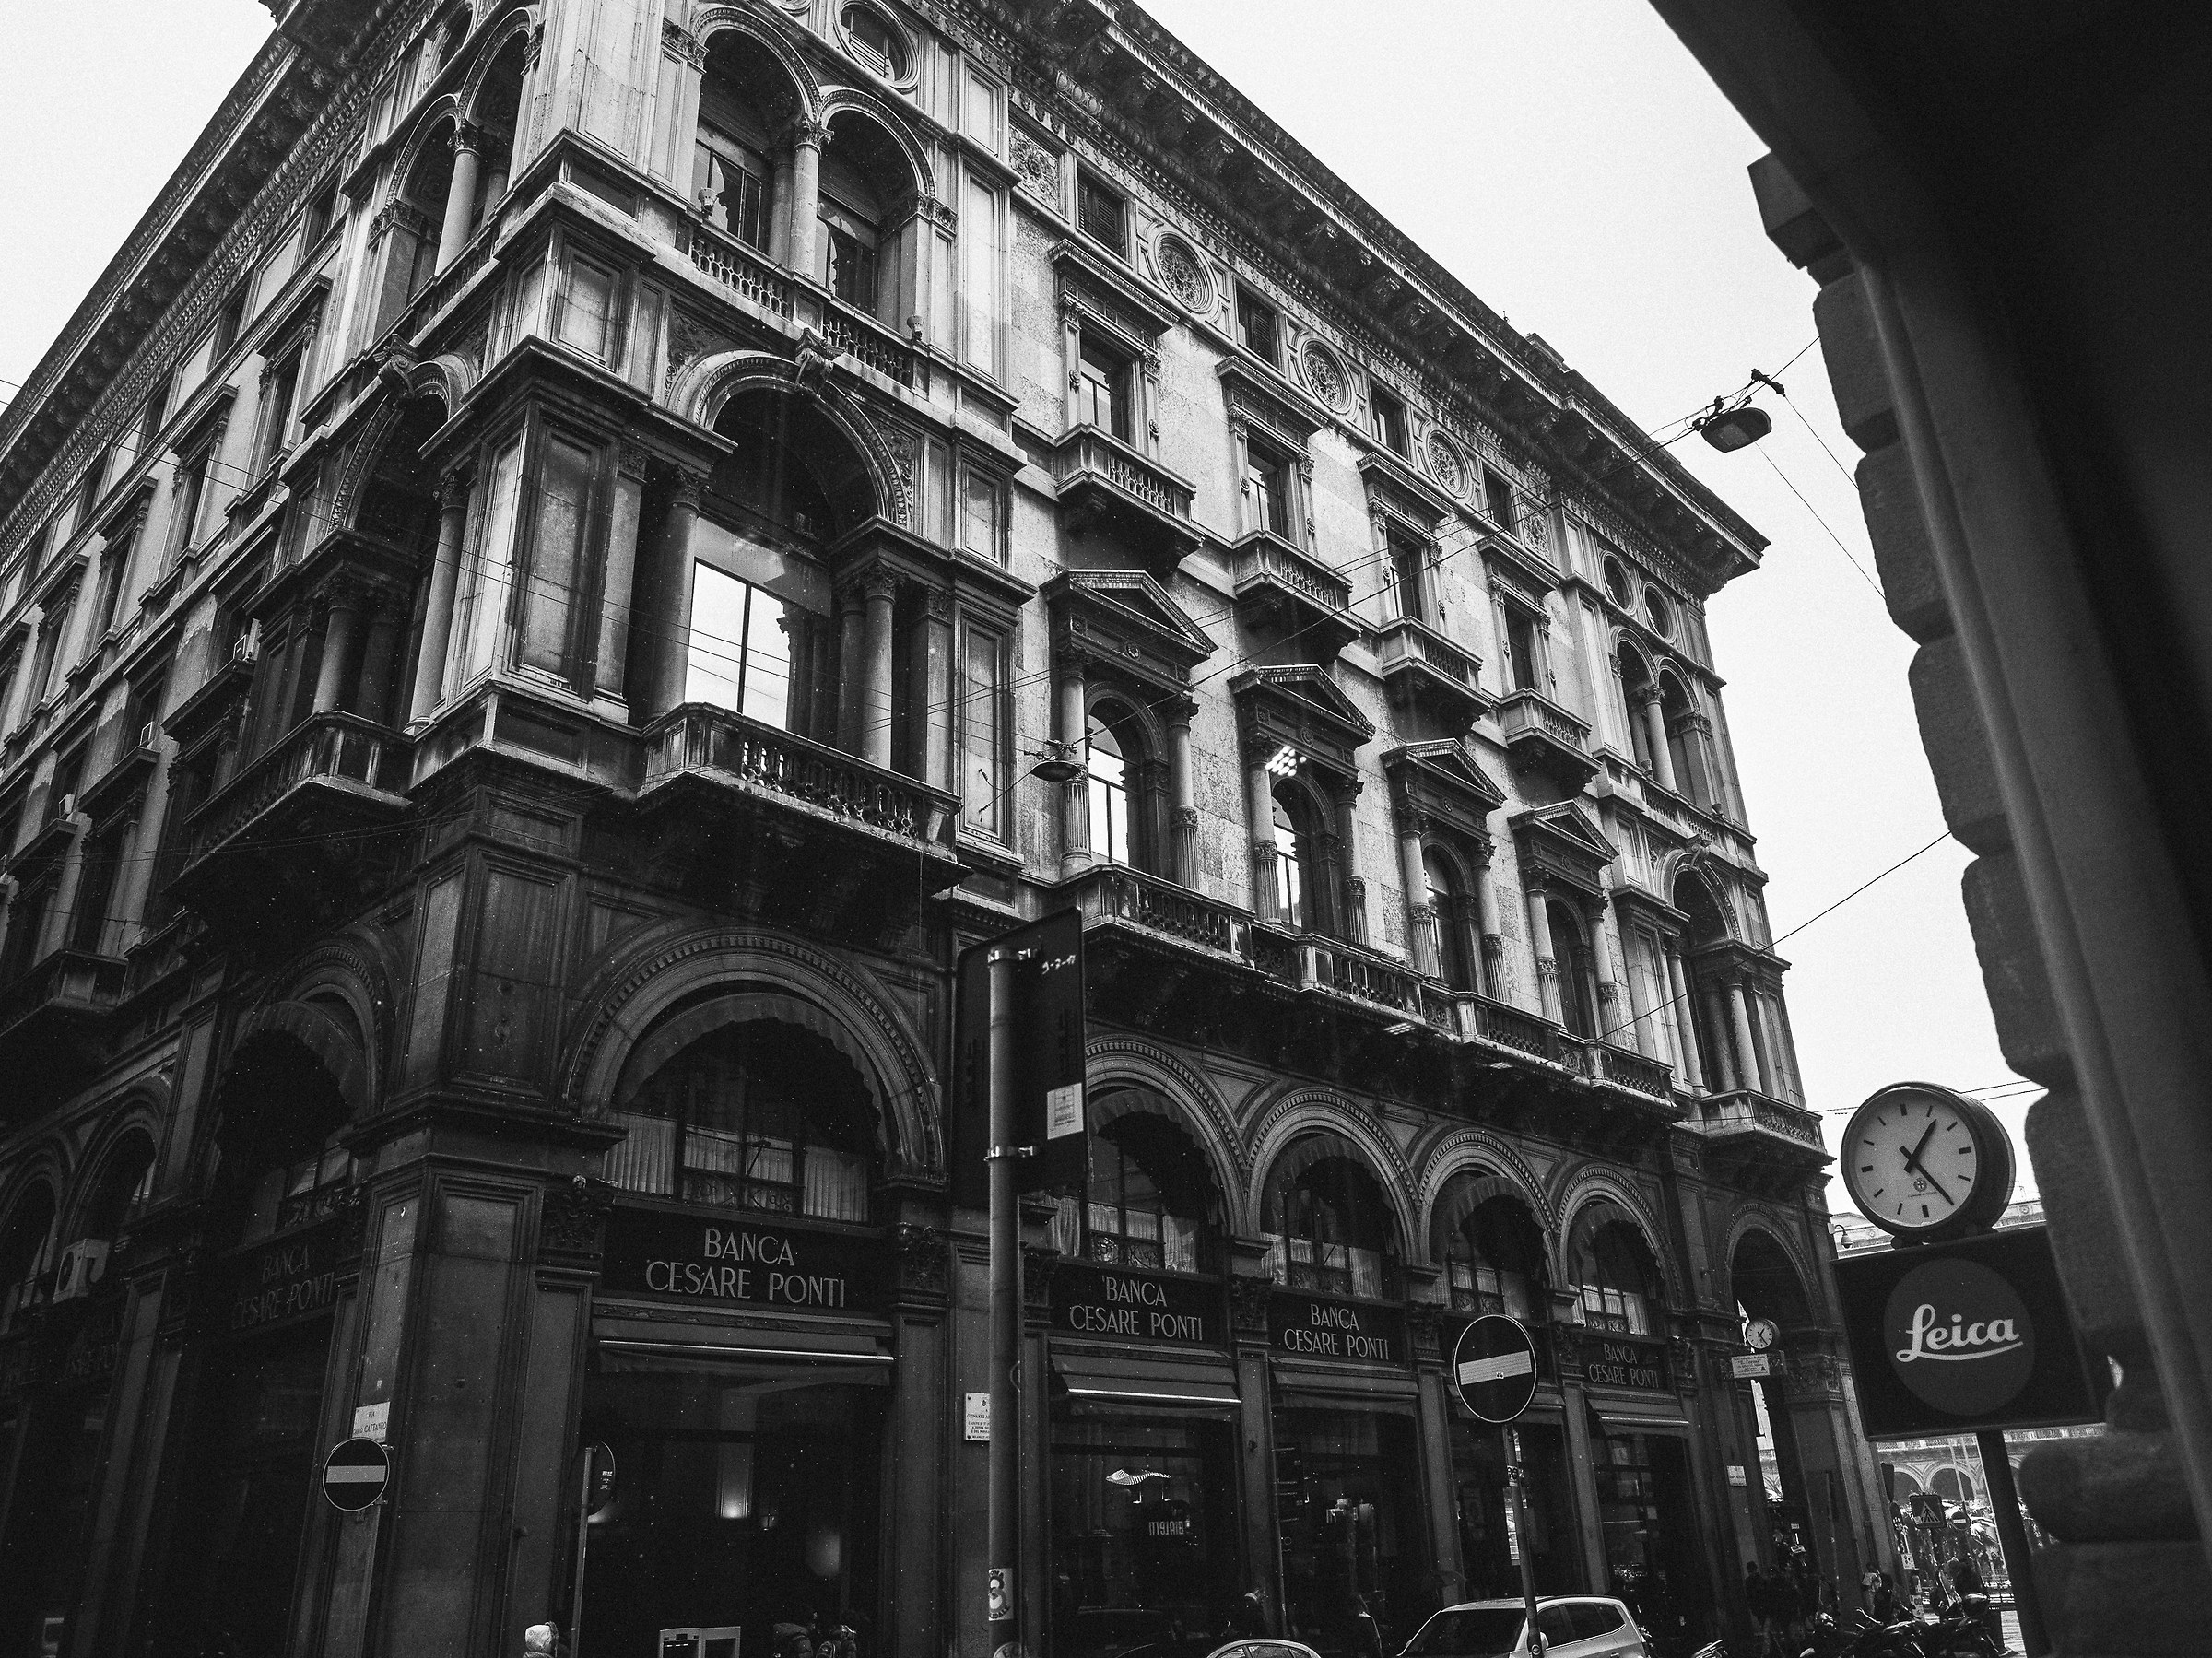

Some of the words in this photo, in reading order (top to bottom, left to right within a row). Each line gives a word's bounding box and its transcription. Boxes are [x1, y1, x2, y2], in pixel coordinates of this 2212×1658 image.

[262, 1244, 310, 1283] BANCA
[704, 1228, 794, 1266] BANCA
[646, 1261, 751, 1299] CESARE
[769, 1272, 845, 1308] PONTI
[1106, 1276, 1167, 1307] BANCA
[1069, 1305, 1140, 1335] CESARE
[1151, 1312, 1203, 1341] PONTI
[1310, 1304, 1359, 1331] BANCA
[1896, 1304, 2023, 1363] Leica
[1284, 1329, 1339, 1356] CESARE
[1347, 1335, 1390, 1360] PONTI
[1604, 1343, 1637, 1364] BANCA
[1588, 1364, 1626, 1385] CESARE
[1630, 1369, 1658, 1389] PONTI
